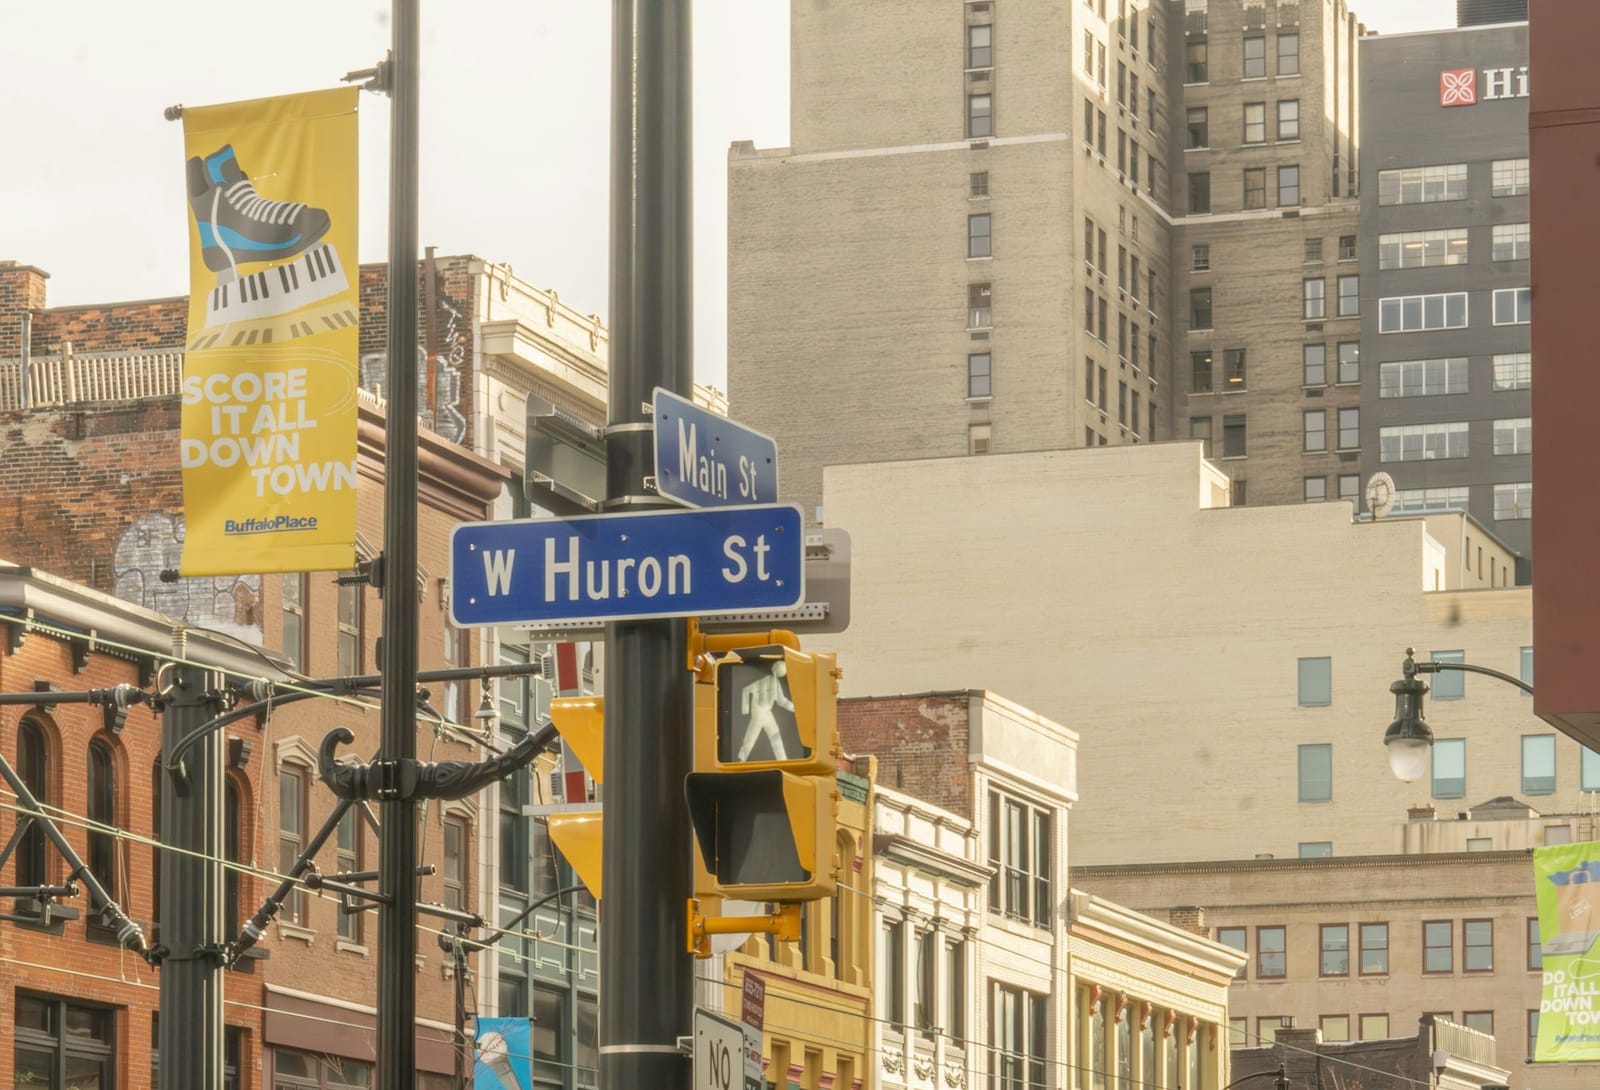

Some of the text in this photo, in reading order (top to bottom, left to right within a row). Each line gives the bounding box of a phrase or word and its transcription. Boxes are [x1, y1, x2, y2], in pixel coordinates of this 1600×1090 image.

[181, 368, 307, 405] SCORE
[211, 399, 317, 435] IT ALL
[181, 432, 299, 468] DOWN
[678, 417, 757, 500] Main St
[251, 460, 358, 497] TOWN
[224, 515, 318, 534] BuffaloPlace
[482, 534, 770, 602] W Huron St
[1542, 970, 1565, 986] DO
[1553, 982, 1600, 998] IT ALL
[1540, 996, 1593, 1014] DOWN
[709, 1040, 731, 1090] NO
